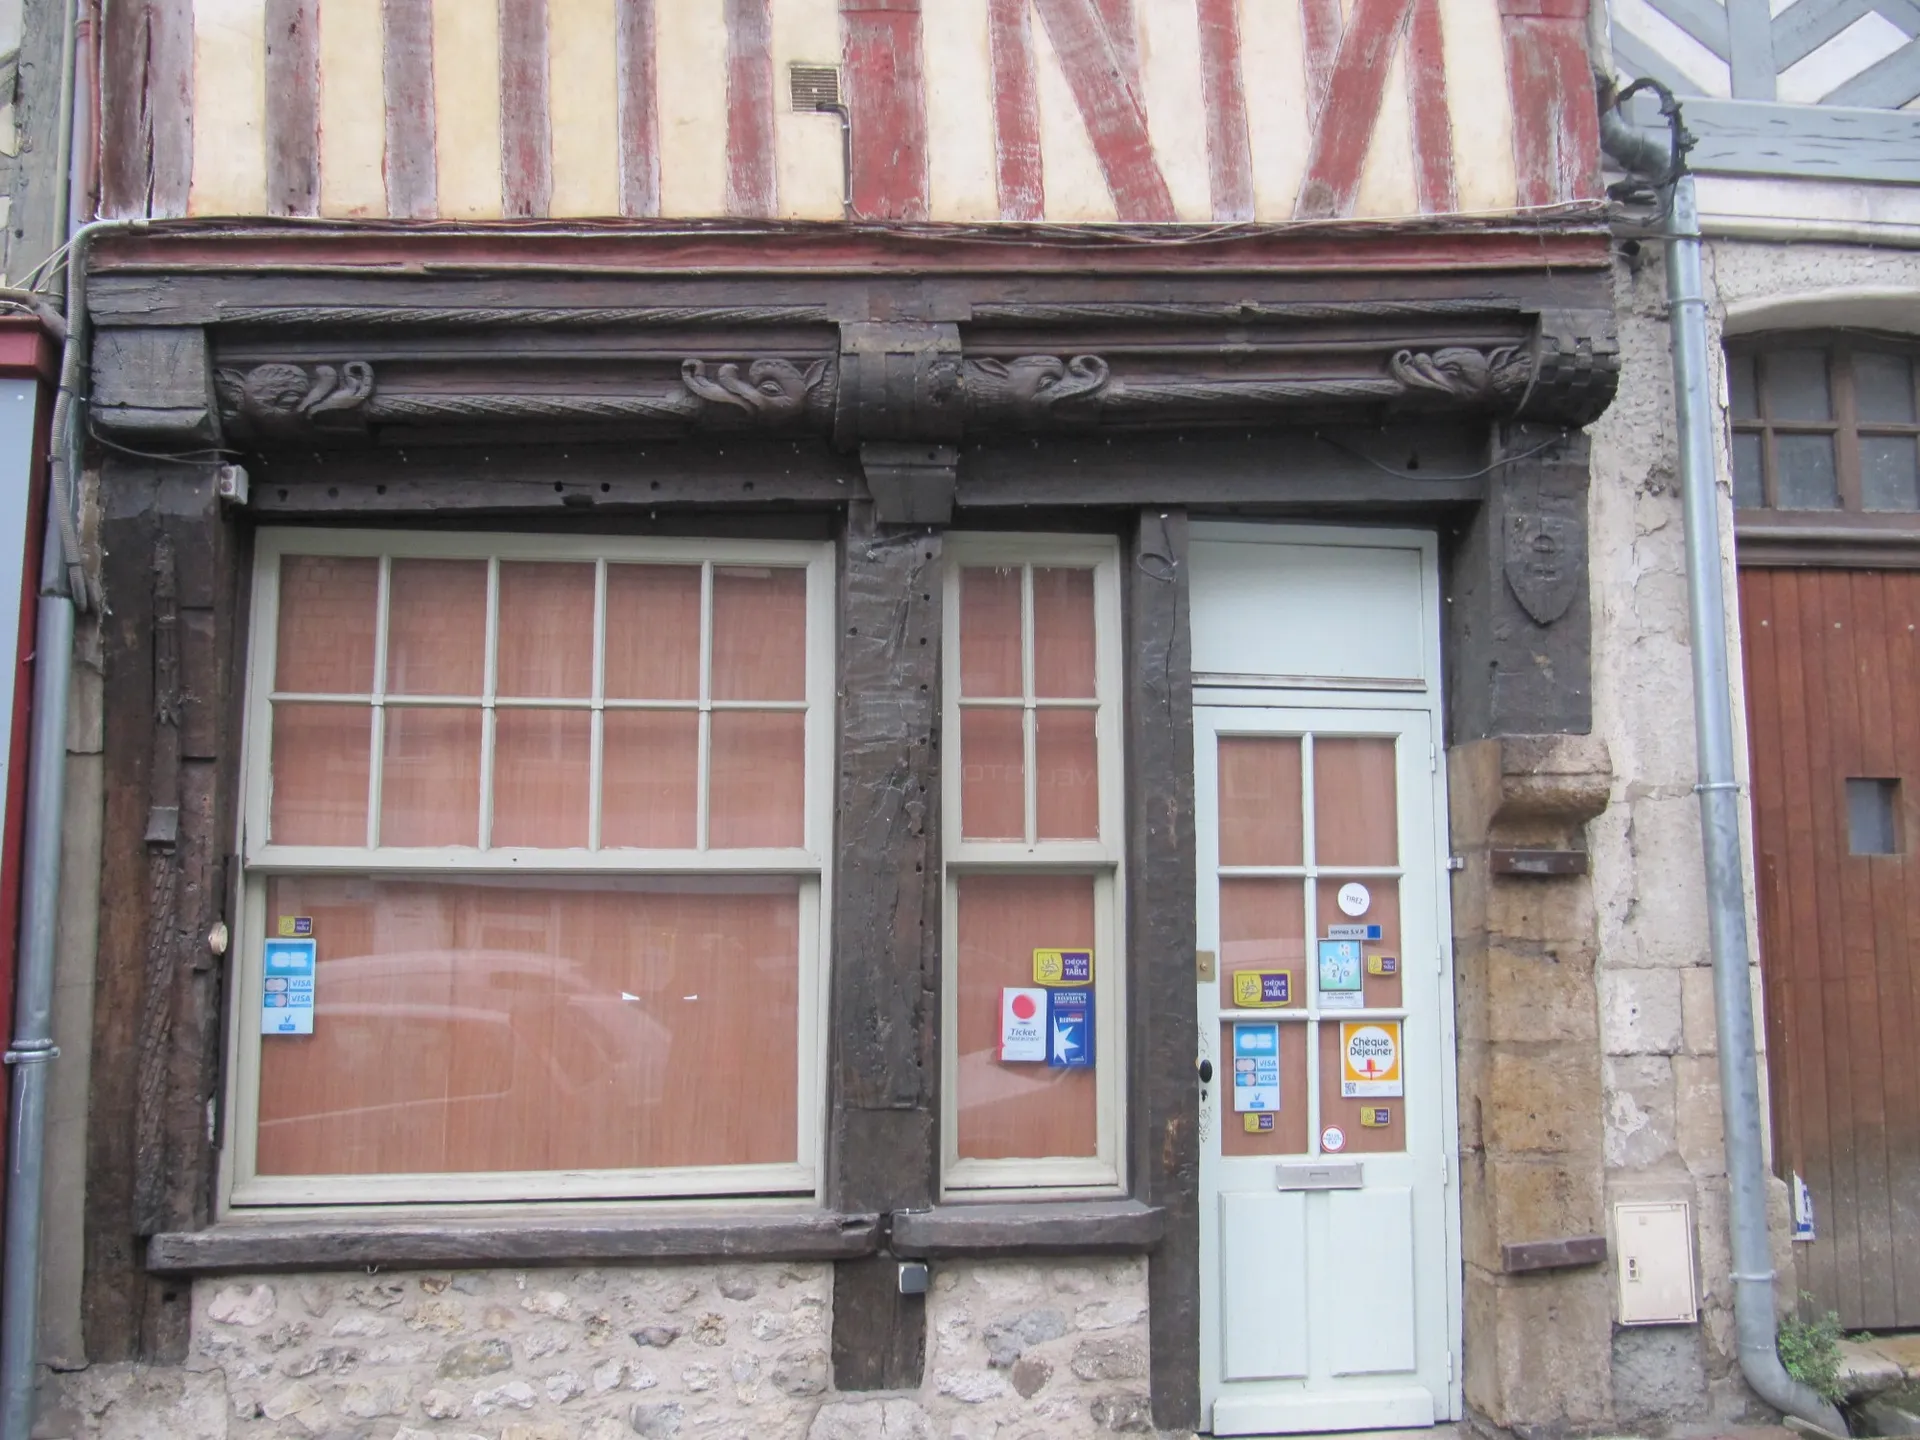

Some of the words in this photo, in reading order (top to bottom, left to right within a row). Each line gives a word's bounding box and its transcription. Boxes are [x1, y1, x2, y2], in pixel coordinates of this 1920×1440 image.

[1346, 895, 1363, 905] TIREZ
[1065, 968, 1087, 976] TABLE
[292, 980, 312, 988] VISA
[1265, 989, 1286, 997] TABLE
[291, 994, 311, 1002] VISA
[1010, 1028, 1037, 1036] Ticket
[1352, 1036, 1389, 1047] Chèque
